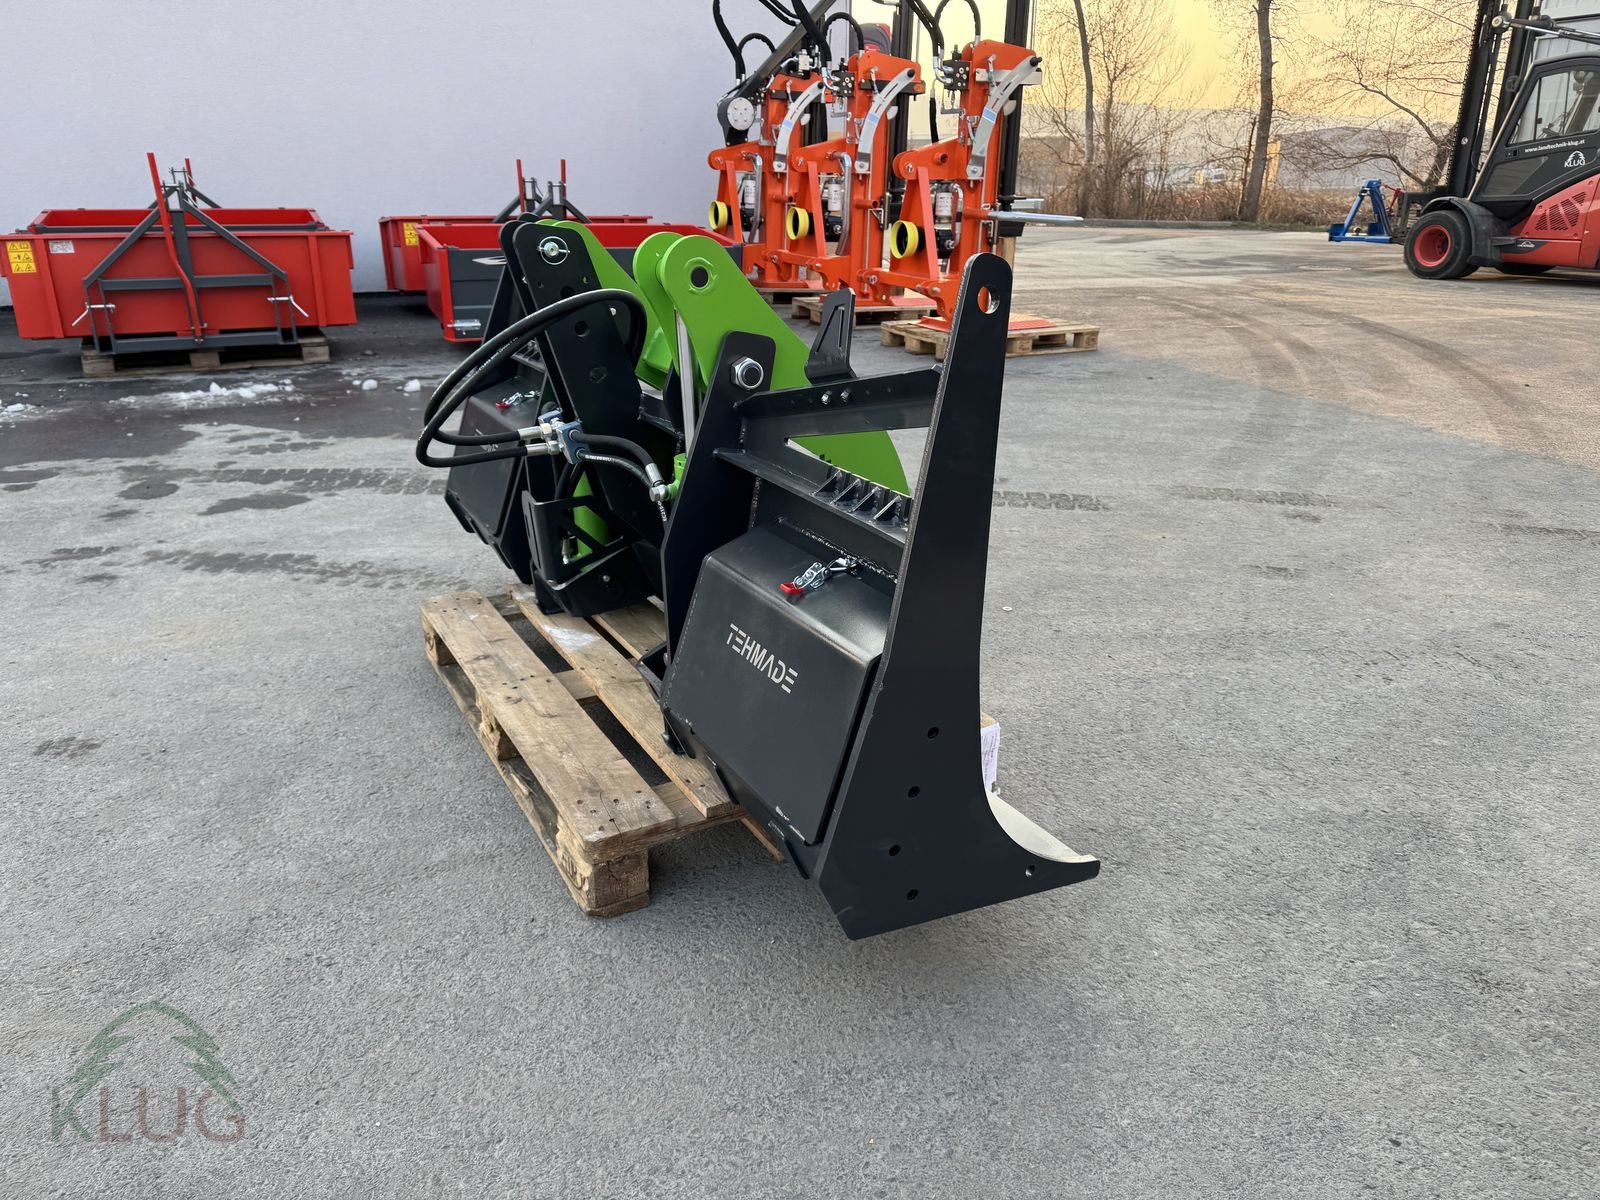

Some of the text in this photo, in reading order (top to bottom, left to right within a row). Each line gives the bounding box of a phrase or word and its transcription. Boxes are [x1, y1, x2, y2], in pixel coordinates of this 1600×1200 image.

[1525, 139, 1585, 153] www.landtechnik-klug.at
[1564, 159, 1586, 168] KLUG
[726, 623, 799, 694] TEHMADE
